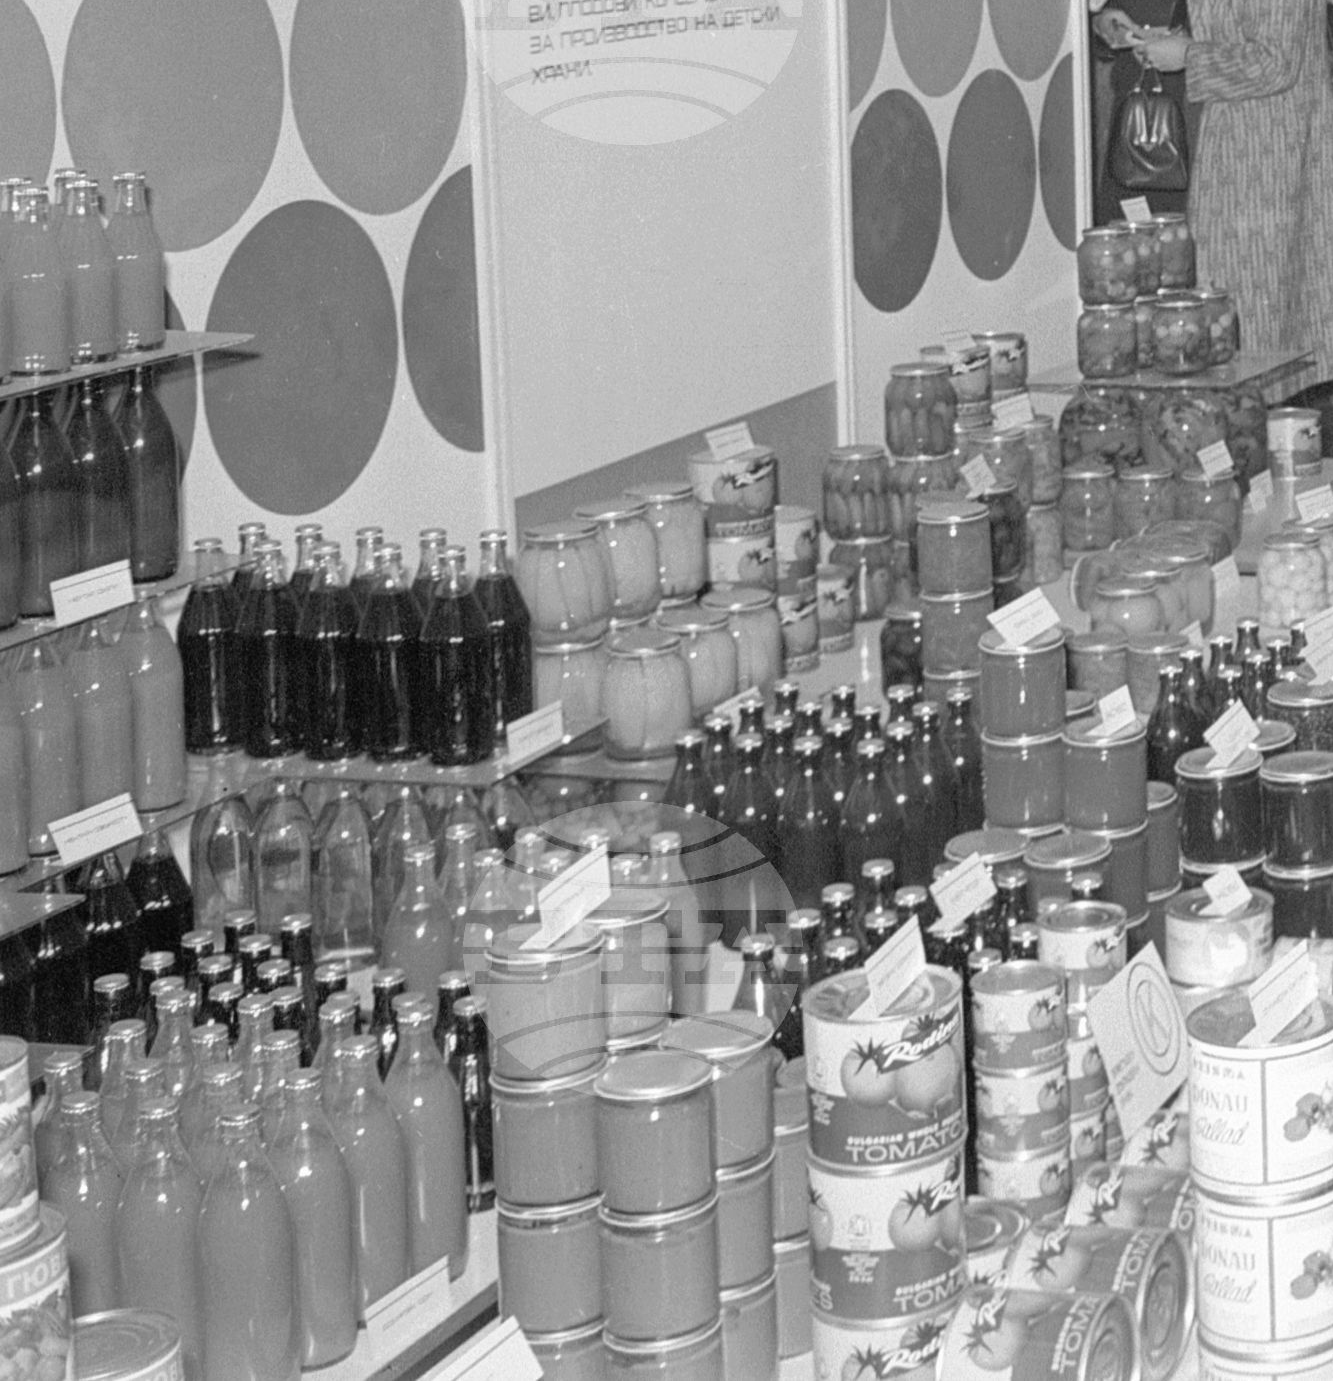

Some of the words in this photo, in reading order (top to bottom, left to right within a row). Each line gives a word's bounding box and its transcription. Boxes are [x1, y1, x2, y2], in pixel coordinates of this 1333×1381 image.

[529, 34, 555, 55] ЗА
[560, 16, 688, 49] ПРОИЗВОДСТВО
[694, 15, 719, 31] НА
[722, 6, 781, 28] ДЕТСКИ
[531, 59, 593, 86] ХРАНИ
[845, 1119, 962, 1163] TOMATO
